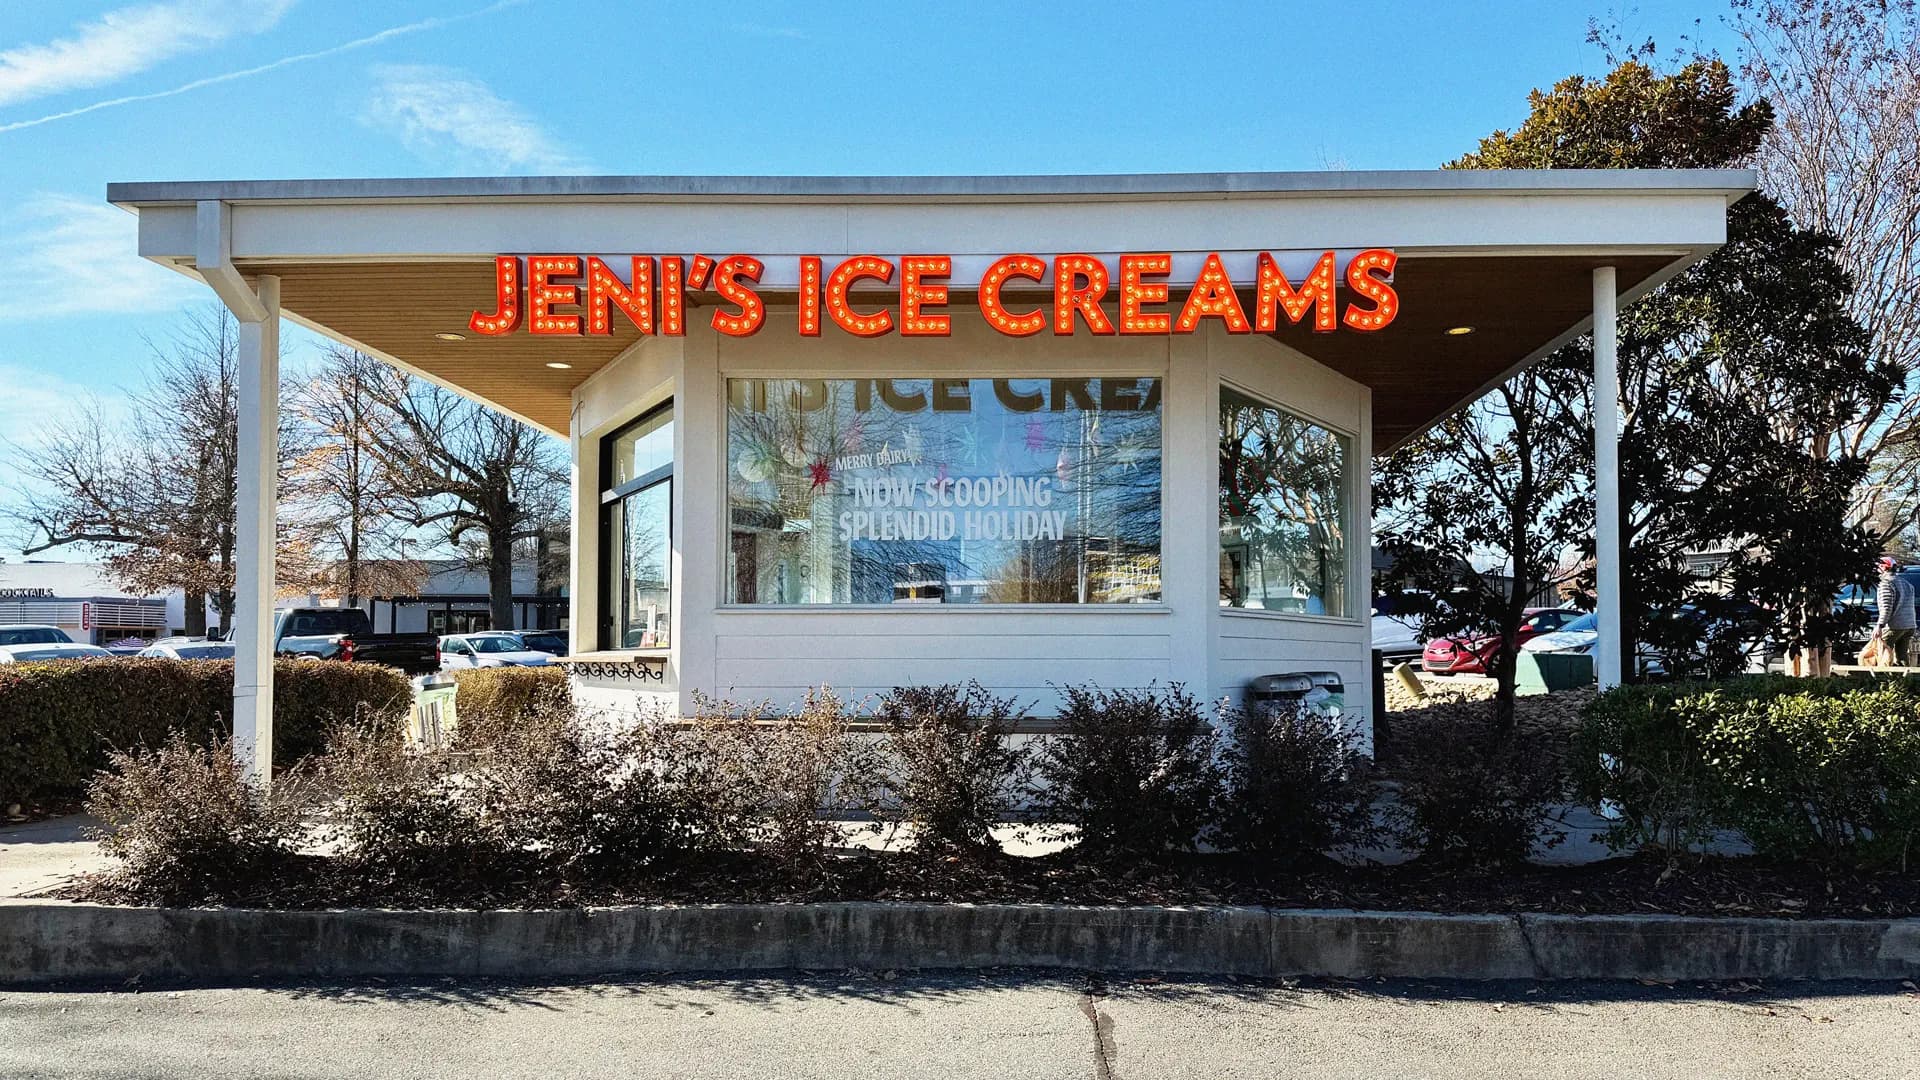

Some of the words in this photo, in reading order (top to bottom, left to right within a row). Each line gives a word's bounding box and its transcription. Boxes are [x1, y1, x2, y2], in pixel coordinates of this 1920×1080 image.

[469, 254, 766, 337] JENI'S
[798, 255, 952, 337] ICE
[977, 248, 1400, 336] CREAMS
[835, 453, 873, 472] MERRY
[853, 476, 918, 508] NOW
[925, 476, 1051, 508] SCOOPING
[838, 510, 956, 541] SPLENDID
[964, 510, 1068, 541] HOLIDAY
[0, 587, 54, 599] COCKTAILS
